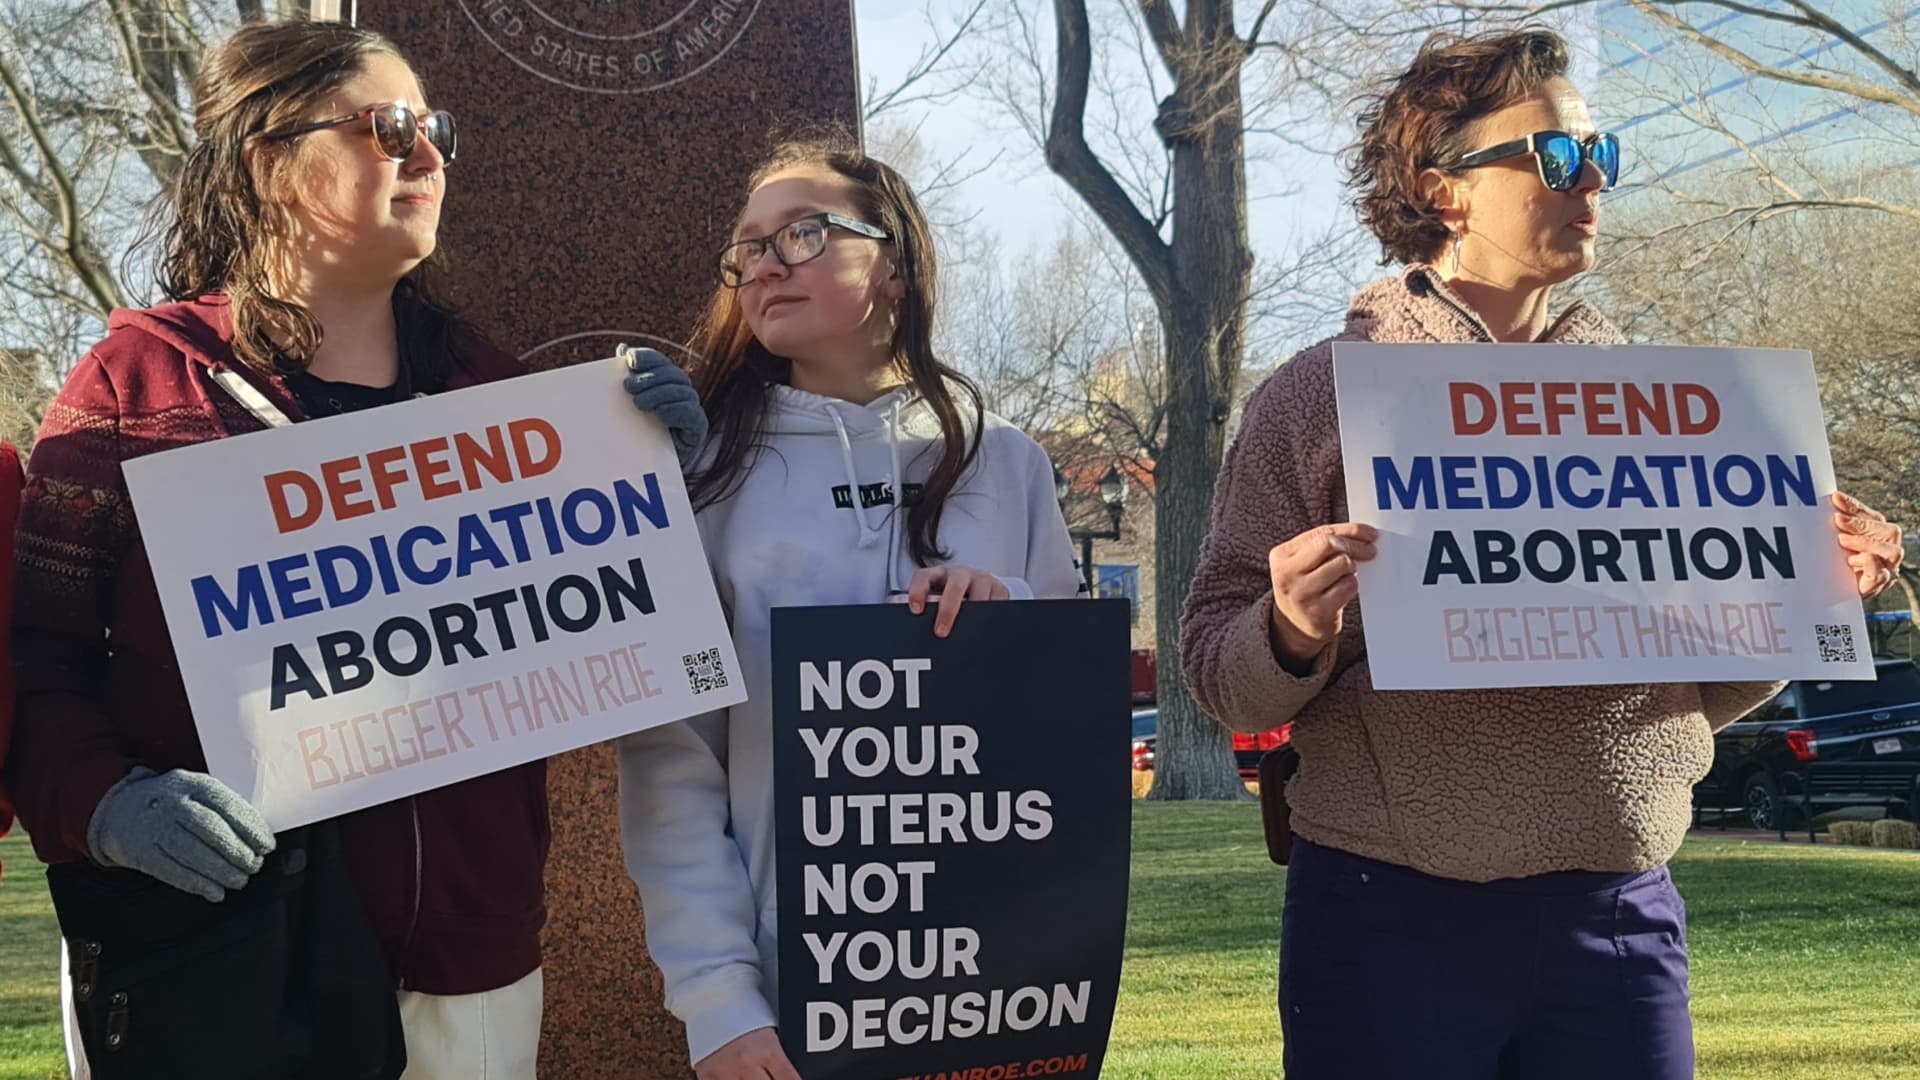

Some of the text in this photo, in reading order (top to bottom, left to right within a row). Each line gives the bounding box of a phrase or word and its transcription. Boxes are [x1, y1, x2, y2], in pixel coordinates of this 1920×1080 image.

[530, 36, 620, 77] STATES
[634, 49, 664, 75] OF
[675, 0, 741, 61] AMERI
[1449, 382, 1721, 436] DEFEND
[266, 418, 561, 532] DEFEND
[1372, 454, 1818, 511] MEDICATION
[190, 472, 670, 639] MEDICATION
[1422, 526, 1796, 586] ABORTION
[269, 557, 657, 712] ABORTION
[1443, 601, 1793, 663] BIGGER THAN ROE
[799, 657, 931, 711] NOT
[296, 641, 663, 791] BIGGER THAN ROE
[798, 725, 980, 778] YOUR
[802, 790, 1054, 847] UTERUS
[804, 861, 936, 915] NOT
[802, 927, 981, 984] YOUR
[805, 980, 1091, 1053] DECISION
